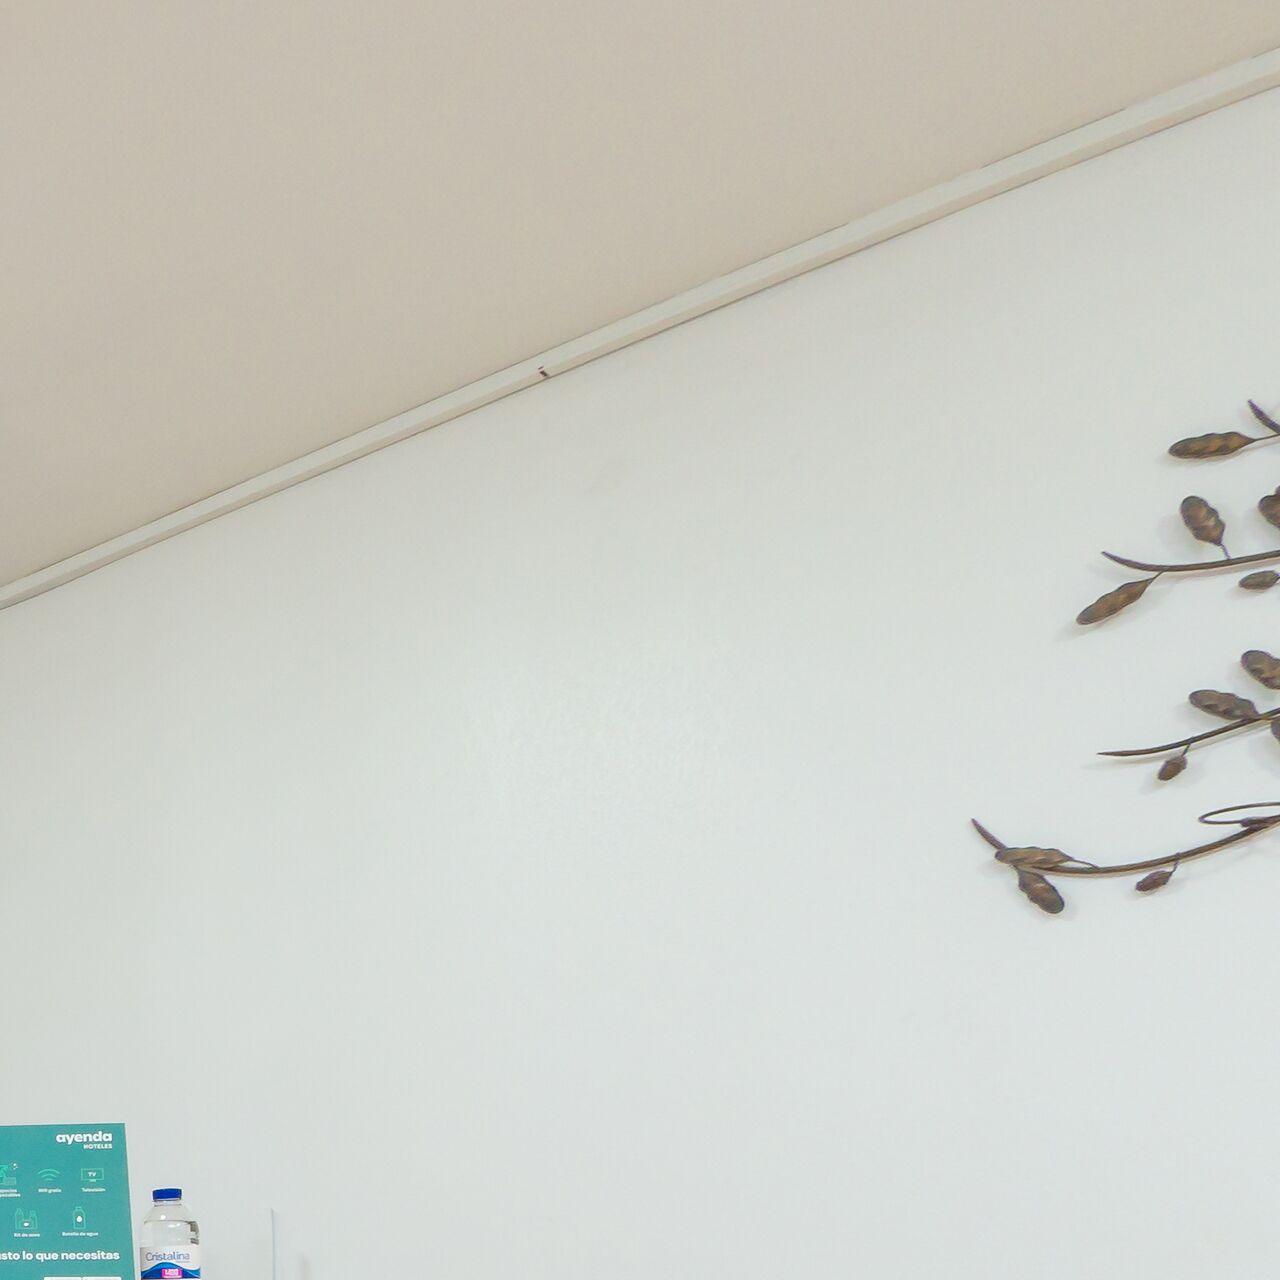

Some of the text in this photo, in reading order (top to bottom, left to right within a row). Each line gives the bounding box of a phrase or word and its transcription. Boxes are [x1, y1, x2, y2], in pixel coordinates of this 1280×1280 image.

[55, 1131, 113, 1145] ayenda
[22, 1250, 33, 1260] lo
[36, 1252, 58, 1262] que
[61, 1250, 120, 1260] necesitas
[145, 1251, 190, 1262] Cristalina
